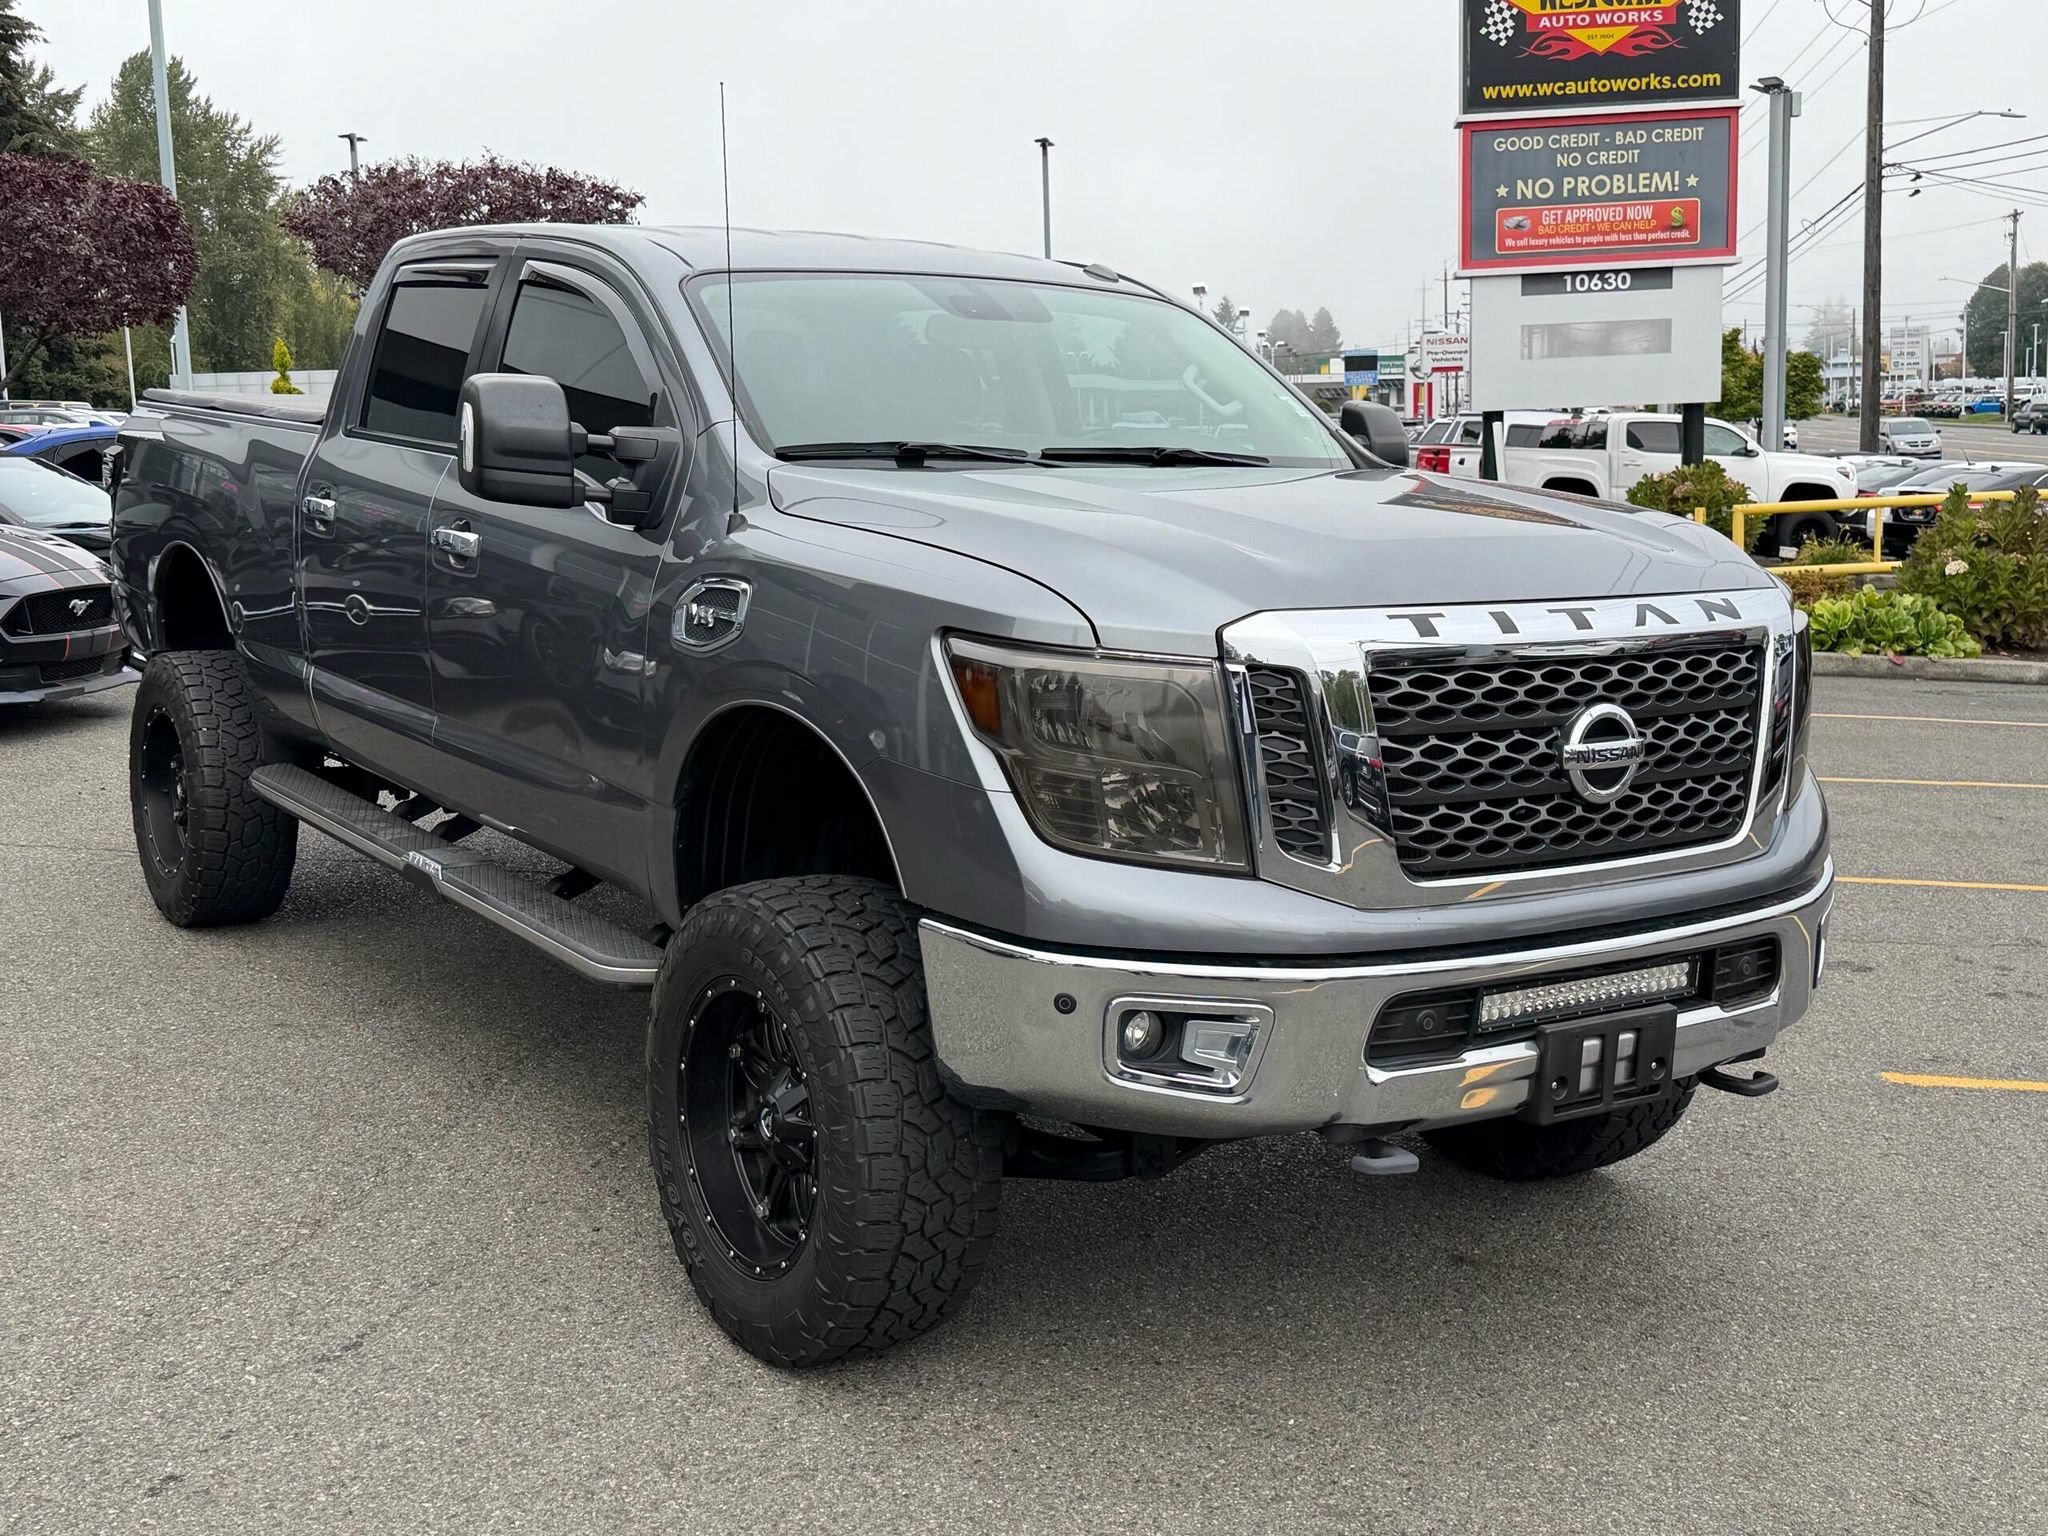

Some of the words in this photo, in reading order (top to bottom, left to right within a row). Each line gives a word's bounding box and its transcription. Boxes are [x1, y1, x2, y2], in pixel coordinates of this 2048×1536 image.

[1538, 14, 1590, 28] AUTO
[1595, 10, 1663, 25] WORKS
[1482, 72, 1721, 99] www.wcautoworks.com
[1494, 136, 1543, 151] GOOD
[1548, 133, 1600, 149] CREDIT
[1615, 130, 1647, 145] BAD
[1651, 127, 1704, 143] CREDIT
[1556, 153, 1582, 168] NO
[1586, 150, 1640, 166] CREDIT
[1516, 177, 1555, 200] NO
[1562, 171, 1680, 197] PROBLEM!
[1542, 209, 1563, 225] GET
[1565, 206, 1624, 224] APPROVED
[1626, 205, 1653, 220] NOW
[1538, 225, 1557, 235] BAD
[1558, 223, 1590, 234] CREDIT
[1596, 222, 1611, 232] WE
[1612, 221, 1632, 231] CAN
[1633, 219, 1657, 230] HELP
[1504, 237, 1516, 247] We
[1516, 237, 1528, 246] sell
[1549, 235, 1575, 245] vehicles
[1575, 235, 1582, 243] to
[1583, 234, 1603, 245] people
[1604, 232, 1618, 242] with
[1619, 232, 1632, 241] less
[1633, 231, 1647, 240] than
[1647, 230, 1670, 242] perfect
[1563, 272, 1632, 292] 10630
[1426, 337, 1468, 346] NISSAN
[1386, 597, 1743, 638] TITAN
[1575, 744, 1643, 764] NISSAN
